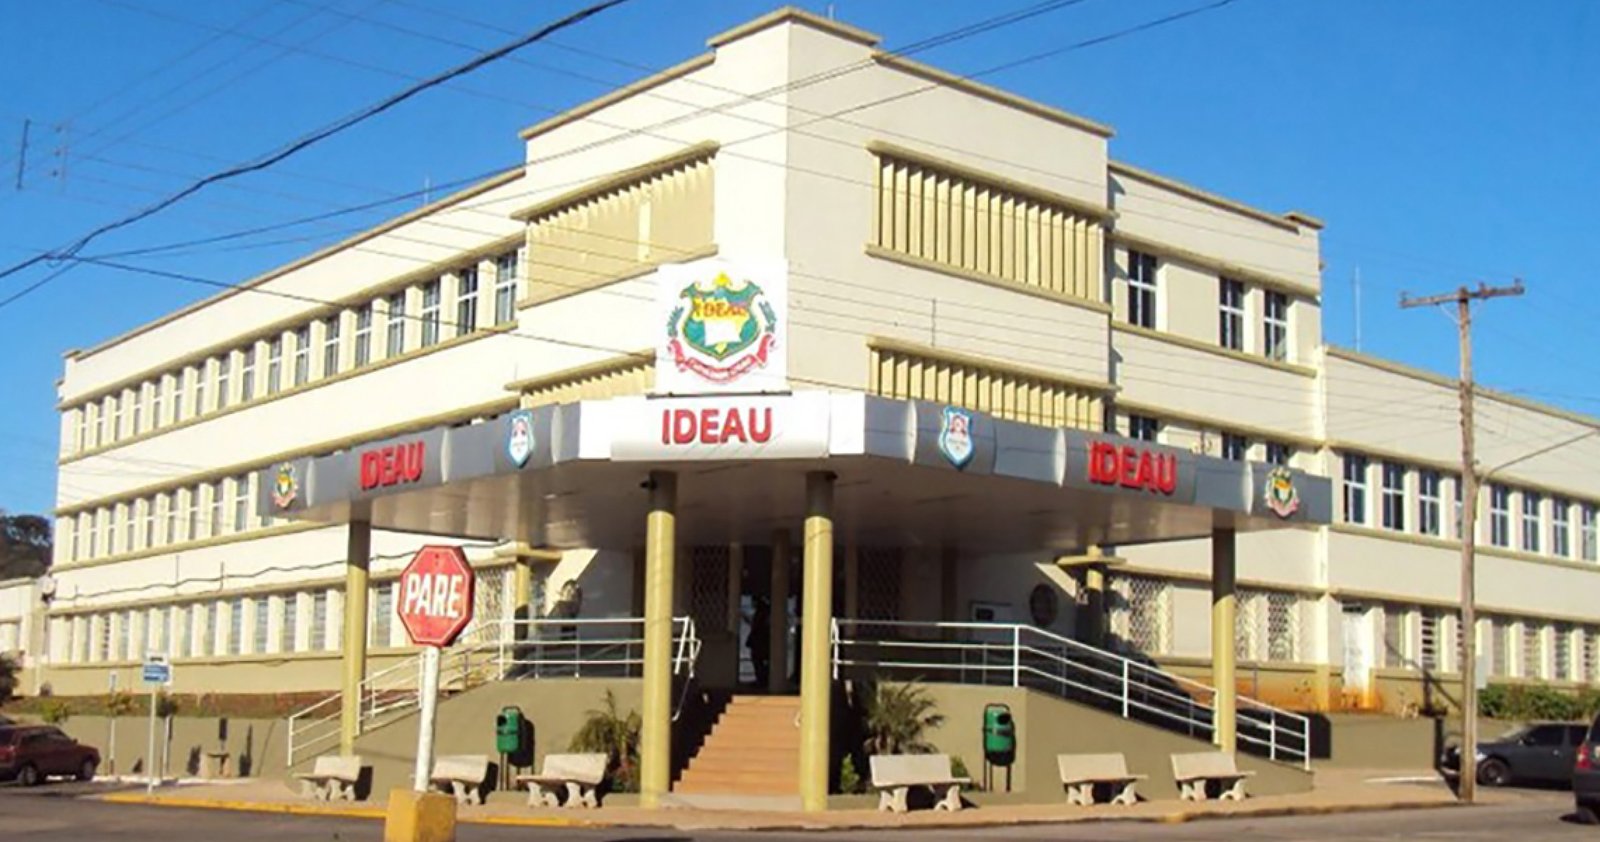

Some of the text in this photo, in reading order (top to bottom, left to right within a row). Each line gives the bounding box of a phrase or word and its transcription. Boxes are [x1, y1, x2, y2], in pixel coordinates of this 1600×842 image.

[662, 407, 772, 445] IDEAU
[360, 440, 424, 489] IDEAU
[1088, 441, 1178, 494] IDEAU
[404, 573, 463, 618] PARE
